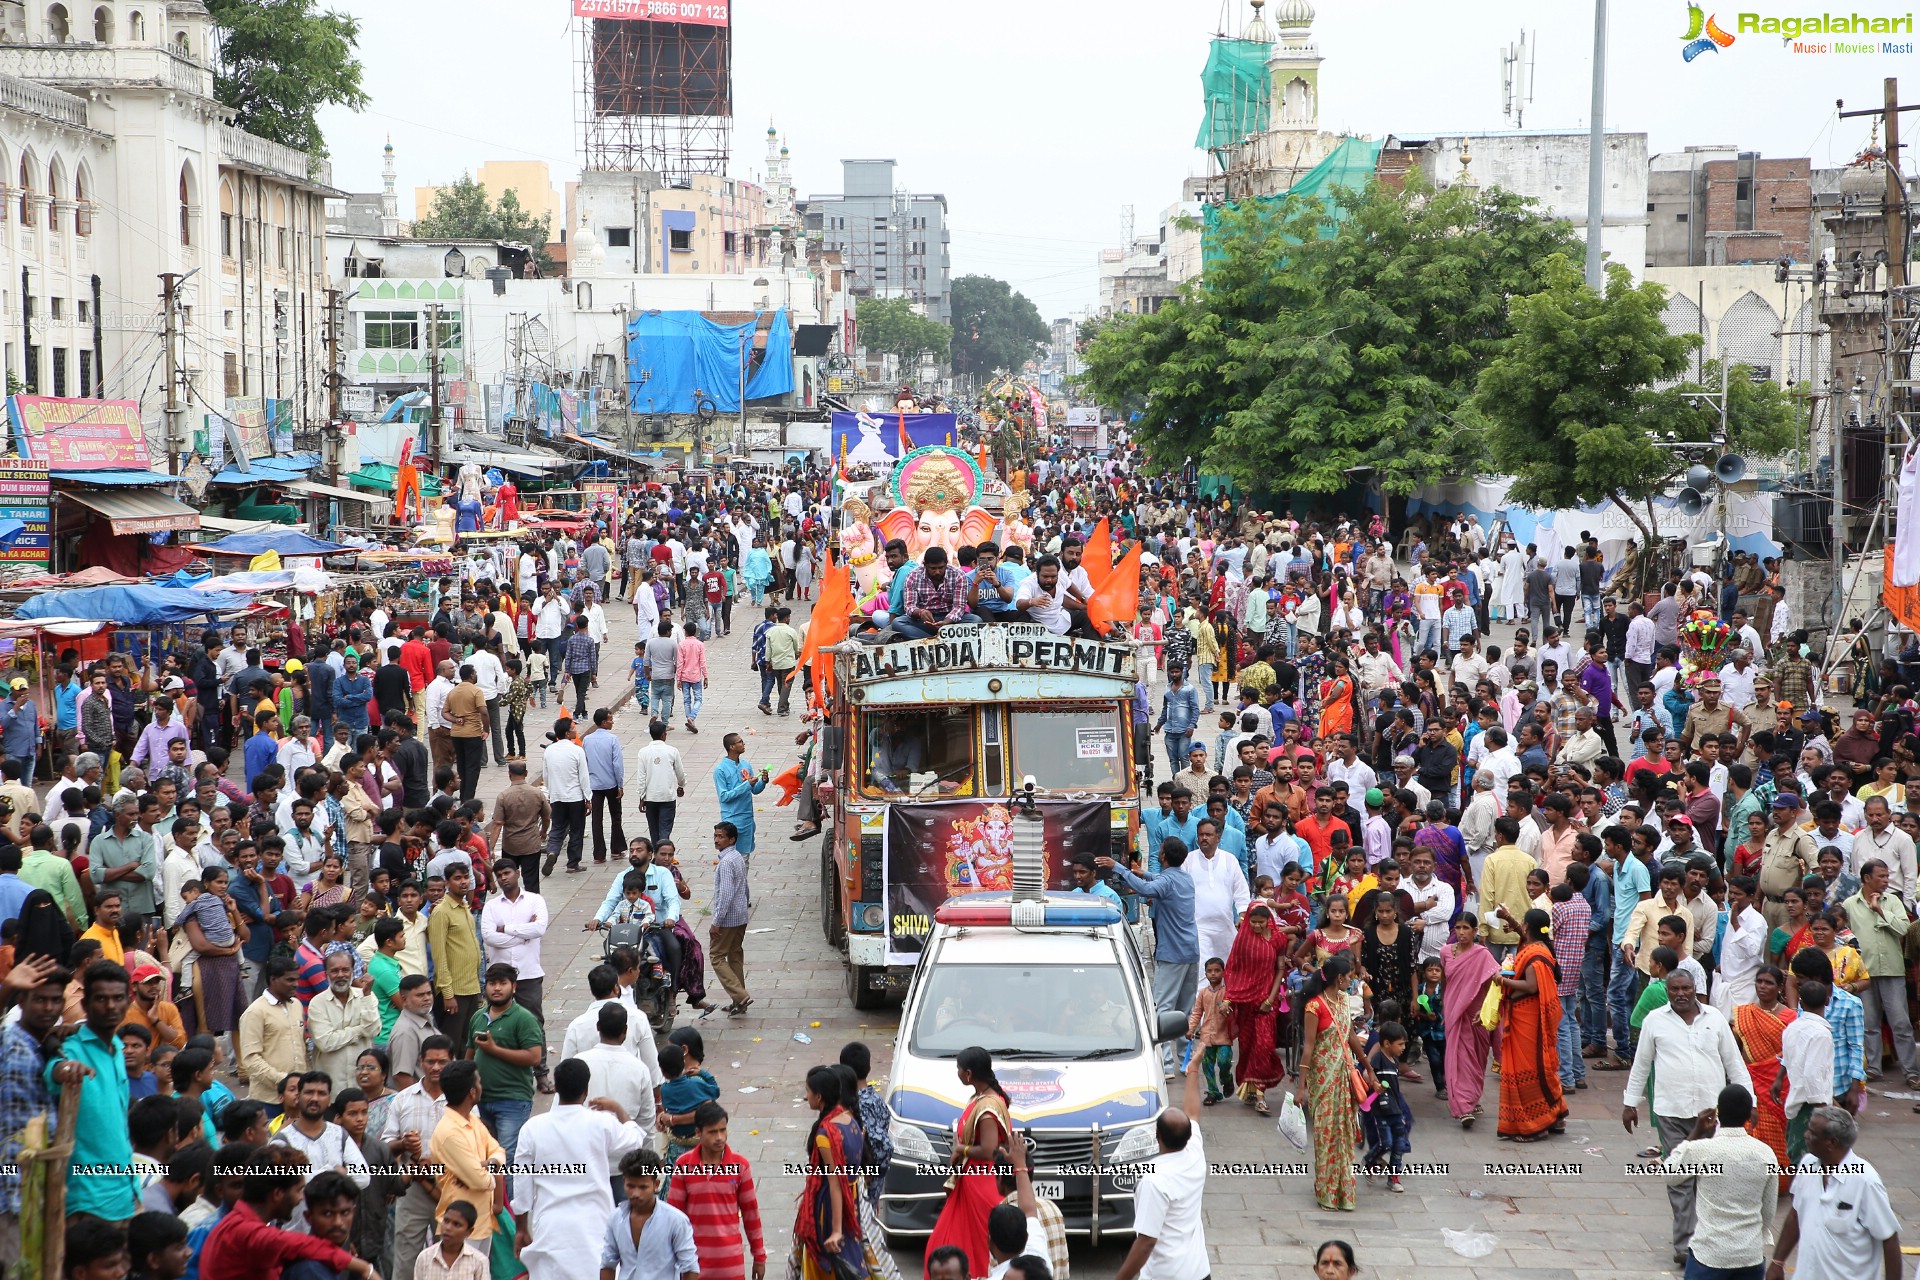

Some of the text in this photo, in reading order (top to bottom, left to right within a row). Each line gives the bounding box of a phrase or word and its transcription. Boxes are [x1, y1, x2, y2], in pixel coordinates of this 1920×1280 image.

[647, 3, 677, 16] 9866
[680, 4, 702, 18] 007
[705, 5, 727, 20] 123
[39, 402, 72, 423] SHAMS
[21, 459, 49, 470] HOTEL
[13, 471, 48, 480] SECTION
[0, 483, 49, 493] DUM BIRYANI
[22, 497, 48, 506] MUTTON
[9, 510, 46, 519] TAHARI
[24, 523, 47, 532] YANI
[136, 520, 155, 530] SHAMS
[155, 518, 172, 529] HOTEL
[15, 537, 37, 545] RICE
[8, 550, 19, 558] KA
[20, 550, 46, 559] ACHAR
[505, 548, 516, 557] 20
[939, 625, 1046, 640] GOODS CARRIER
[856, 640, 1131, 679] ALL INDIA PERMIT
[893, 914, 930, 936] SHIVA
[1118, 1176, 1134, 1186] Dial
[1035, 1185, 1060, 1198] 1741
